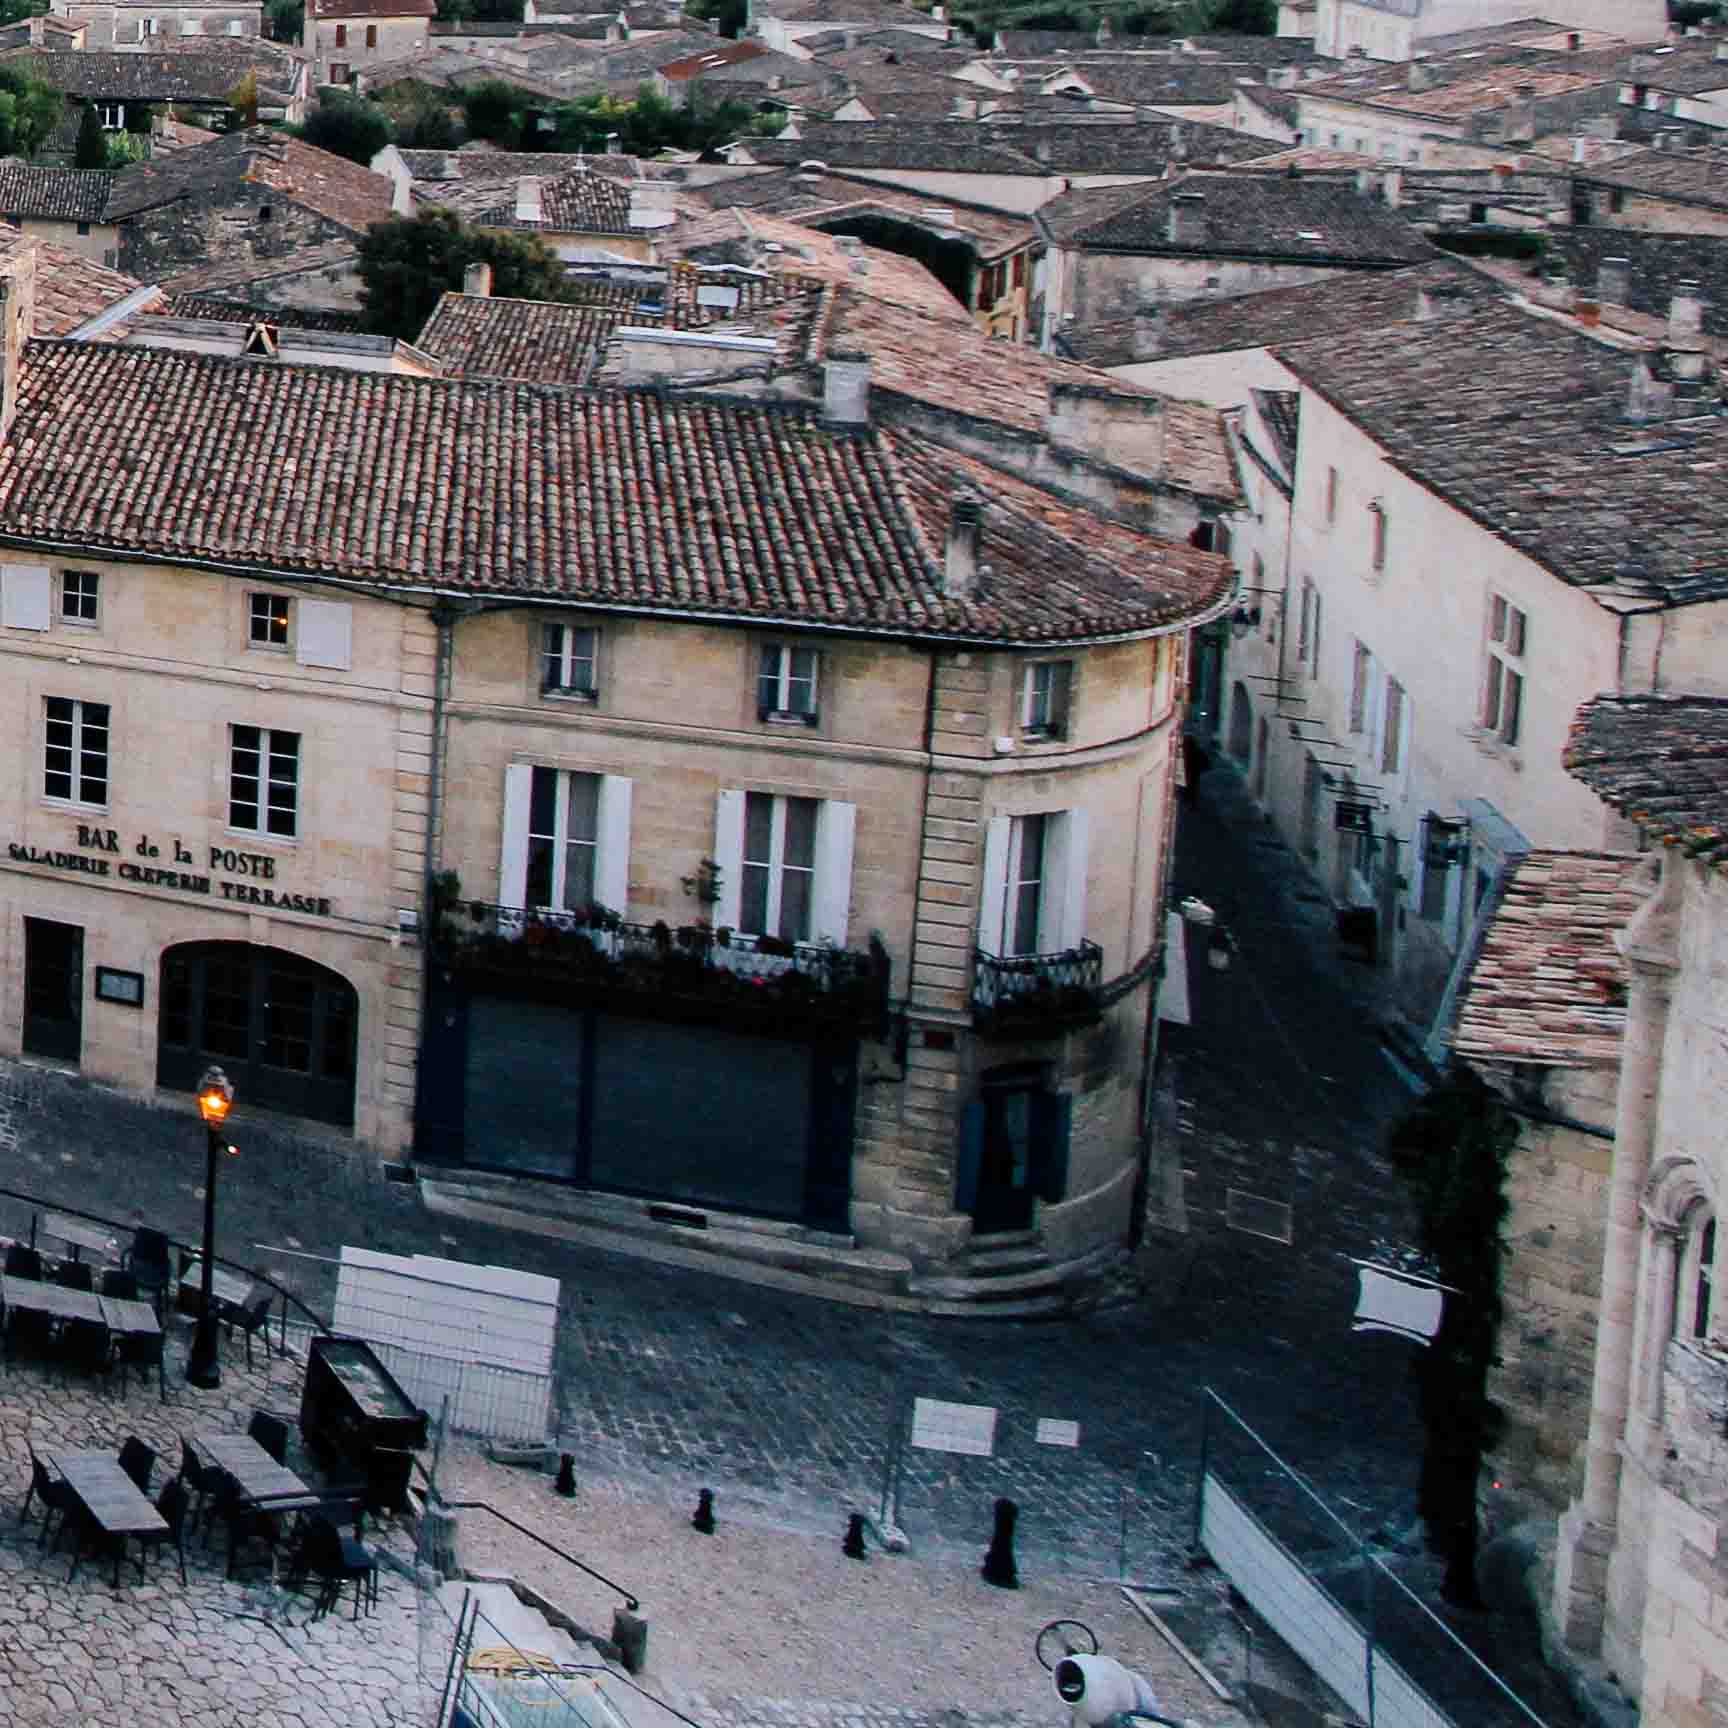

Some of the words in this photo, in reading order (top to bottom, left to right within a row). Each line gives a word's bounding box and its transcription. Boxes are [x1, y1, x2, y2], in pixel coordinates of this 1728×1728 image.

[7, 842, 110, 875] SALADERIE
[220, 880, 331, 915] TERRASSE
[76, 824, 121, 853] BAR
[135, 834, 160, 858] de
[174, 839, 193, 865] la
[209, 846, 276, 880] POSTE
